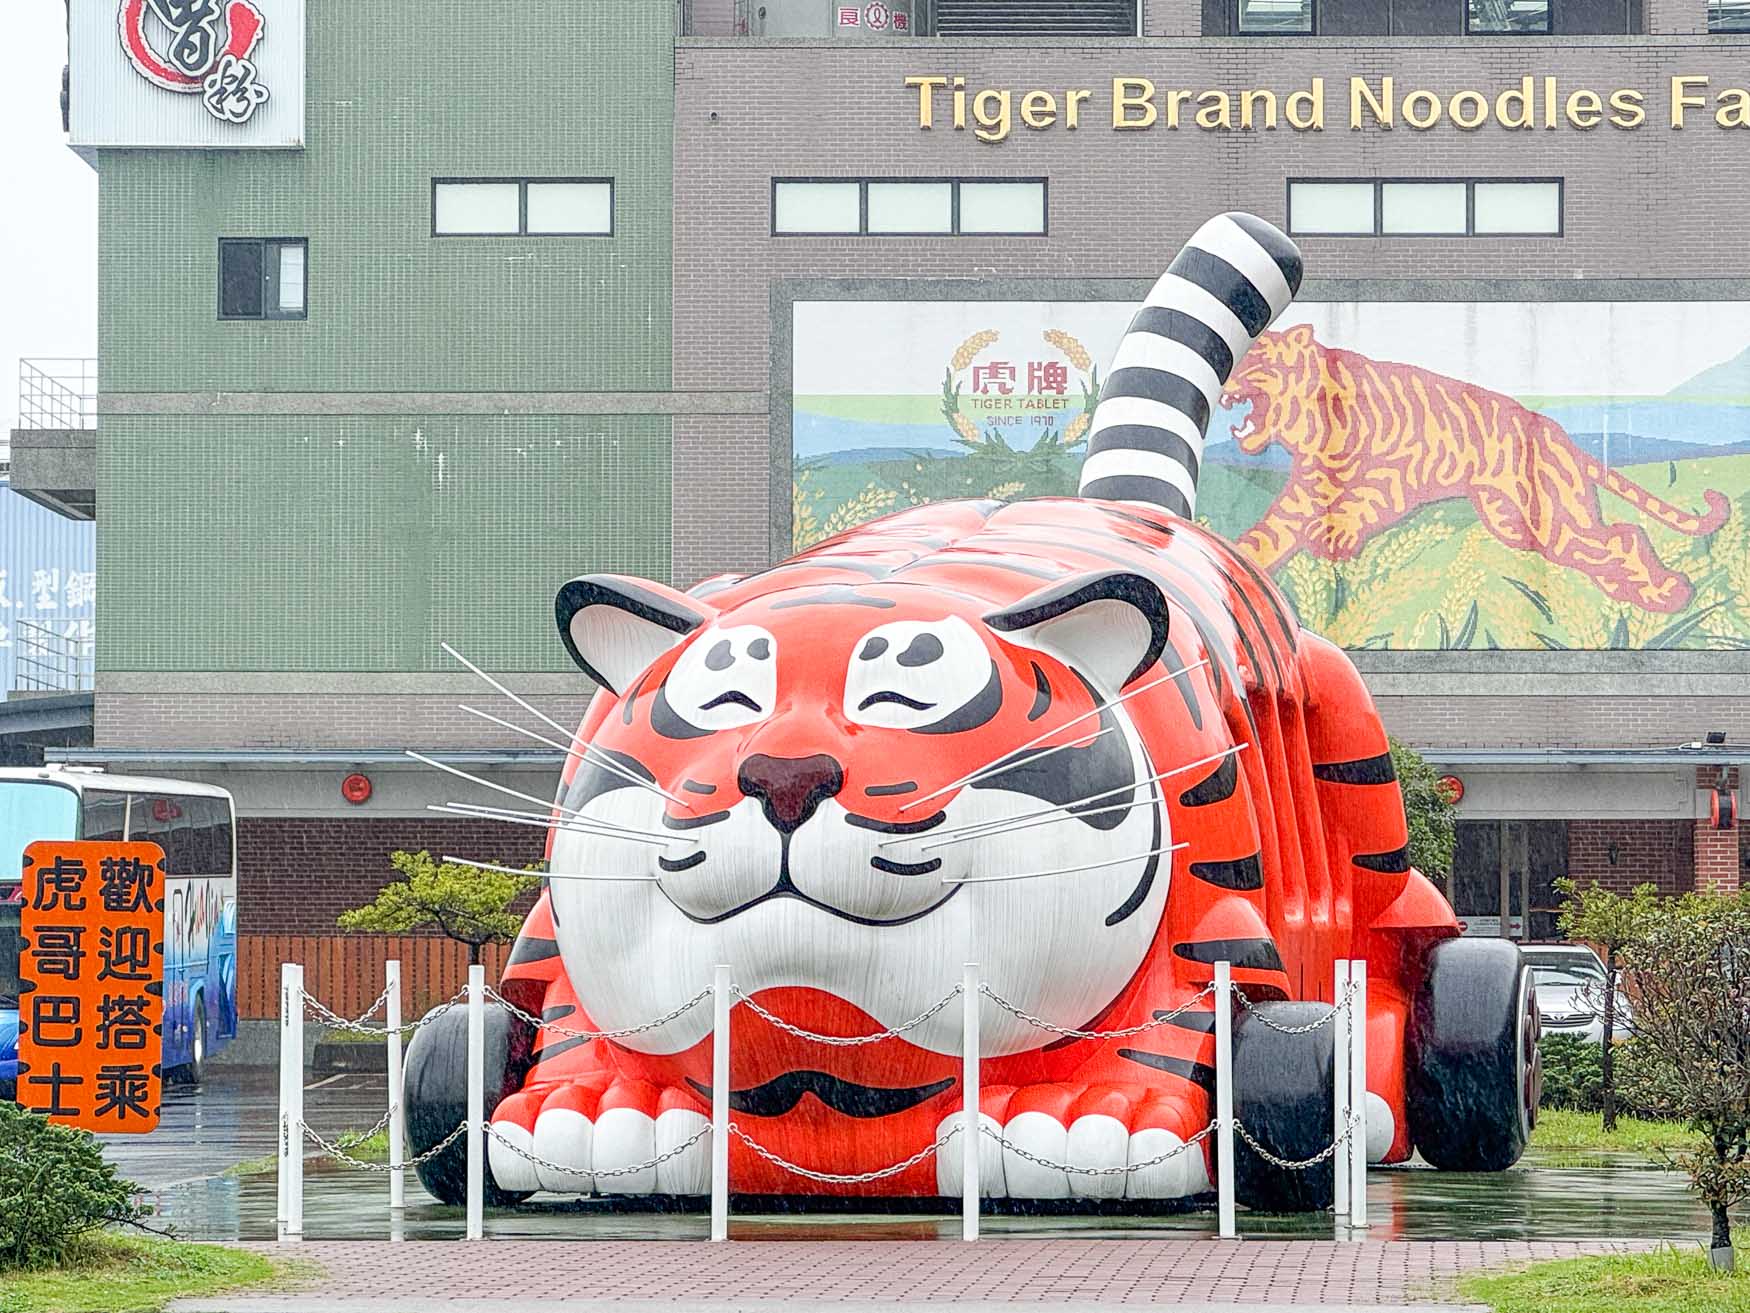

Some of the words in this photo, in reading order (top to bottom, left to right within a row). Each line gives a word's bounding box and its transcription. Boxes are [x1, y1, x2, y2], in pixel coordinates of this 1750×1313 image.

[904, 75, 1092, 144] Tiger
[1112, 76, 1325, 131] Brand
[1350, 75, 1647, 131] Noodles
[1670, 75, 1750, 131] Fa
[972, 398, 1012, 409] TIGER
[1018, 398, 1069, 409] TABLET
[973, 361, 1068, 395] 虎牌
[986, 415, 1023, 427] SINCE
[1030, 415, 1054, 426] 1970
[28, 856, 87, 1117] 虎哥巴士
[94, 856, 154, 1120] 歡迎搭乘
